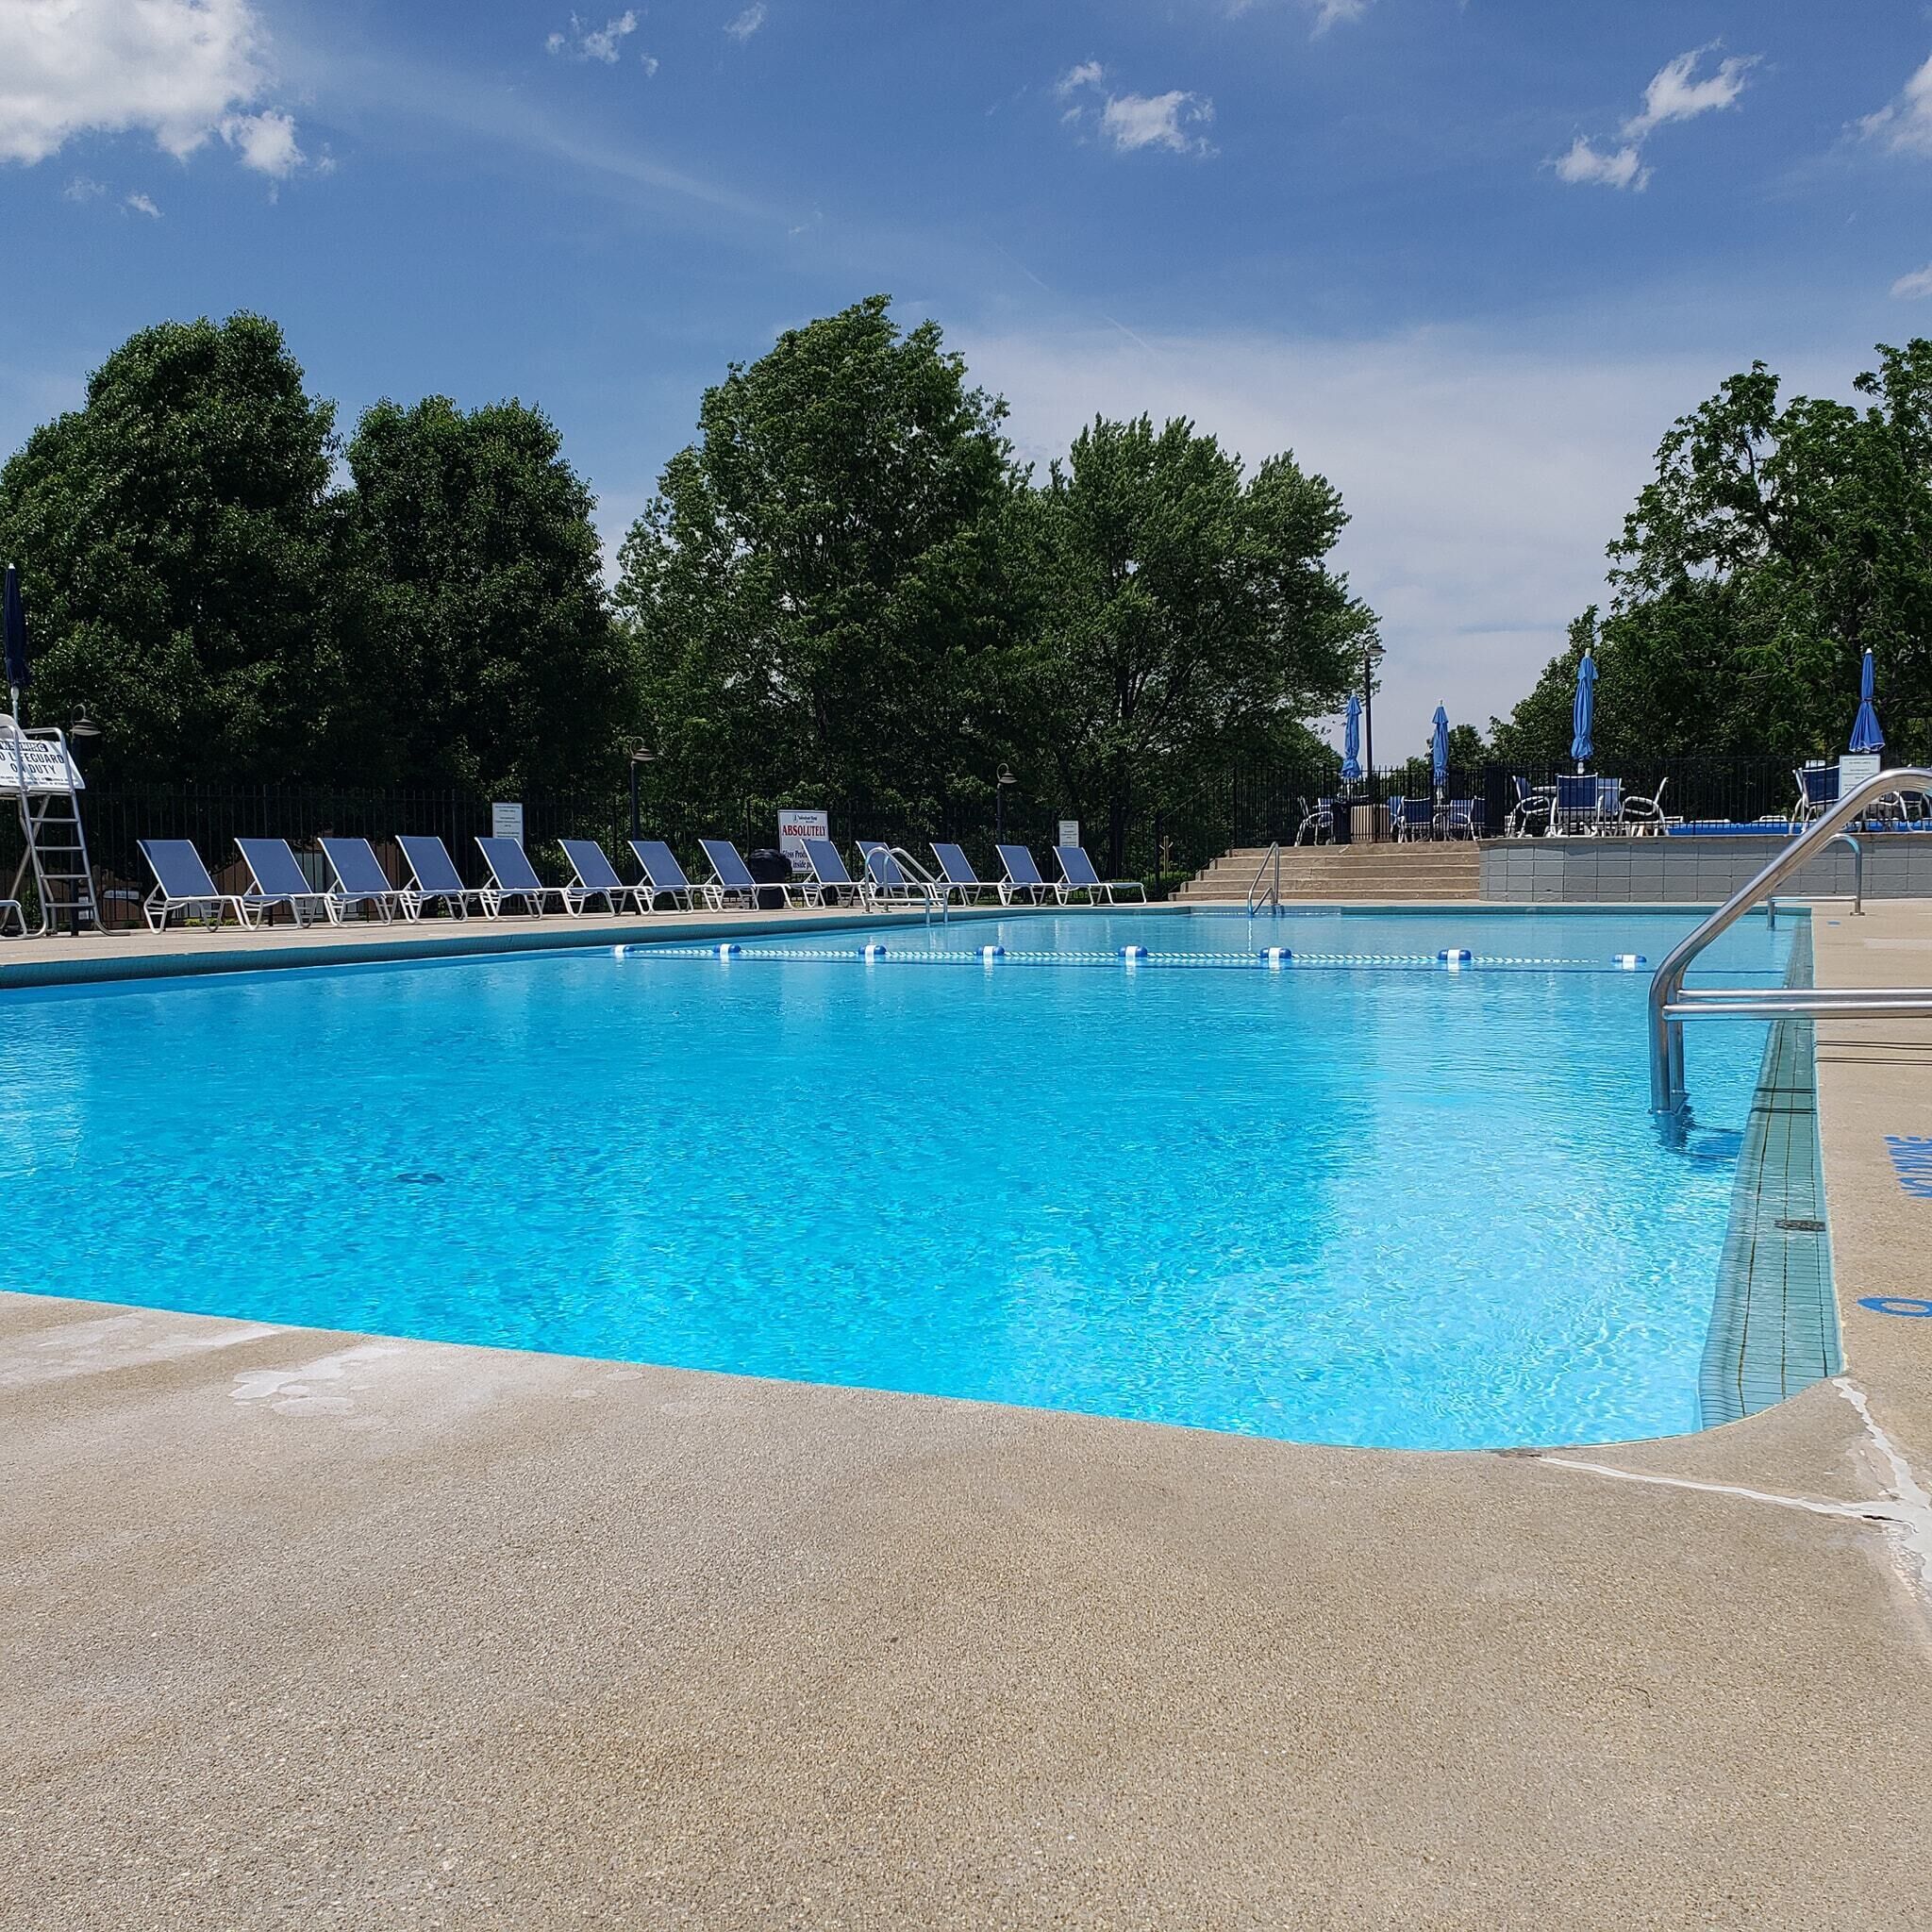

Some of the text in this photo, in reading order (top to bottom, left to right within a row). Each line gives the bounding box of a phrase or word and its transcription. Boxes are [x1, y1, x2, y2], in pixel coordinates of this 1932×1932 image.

[3, 741, 46, 752] WANING
[8, 752, 65, 763] LEGUARD
[28, 764, 56, 774] DUTY
[782, 825, 826, 836] ABSOLUTELY
